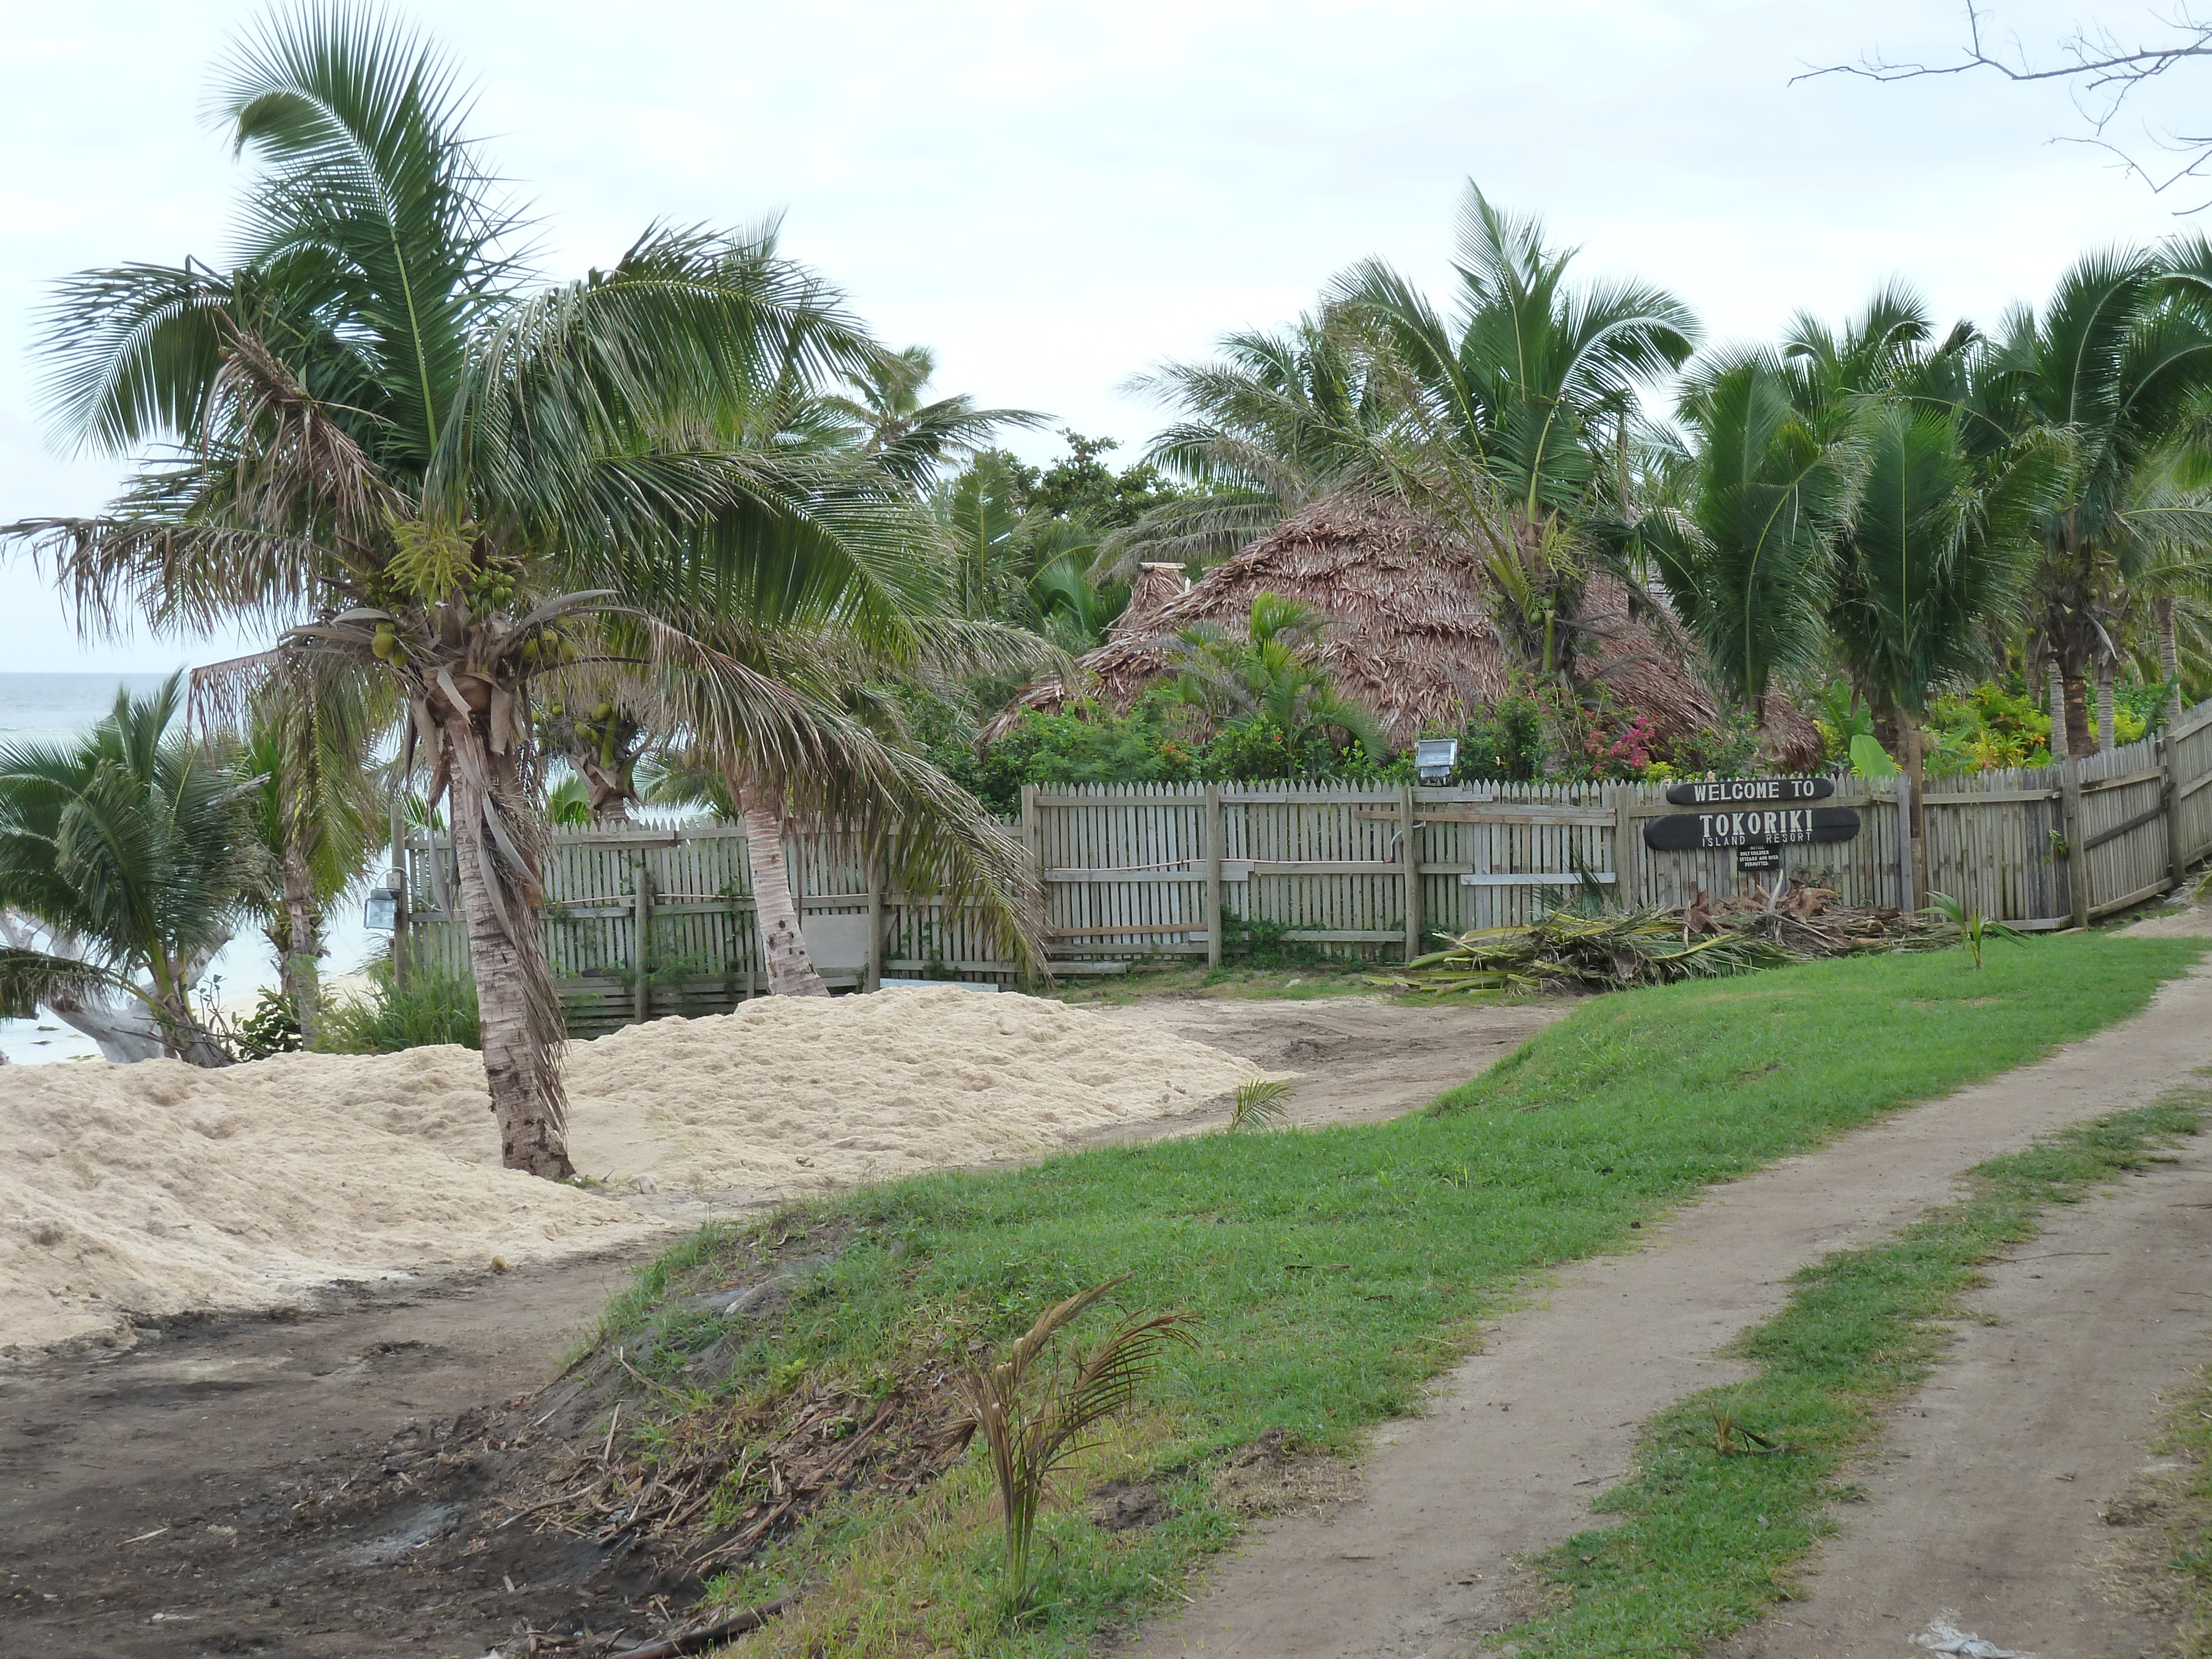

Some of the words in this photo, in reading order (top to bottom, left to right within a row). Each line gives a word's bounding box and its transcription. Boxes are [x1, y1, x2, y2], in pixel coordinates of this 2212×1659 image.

[1694, 781, 1780, 801] WELCOME
[1791, 780, 1814, 797] TO
[1699, 810, 1813, 837] TOKORIKI
[1702, 836, 1746, 847] ISLAND
[1766, 832, 1812, 843] RESORT
